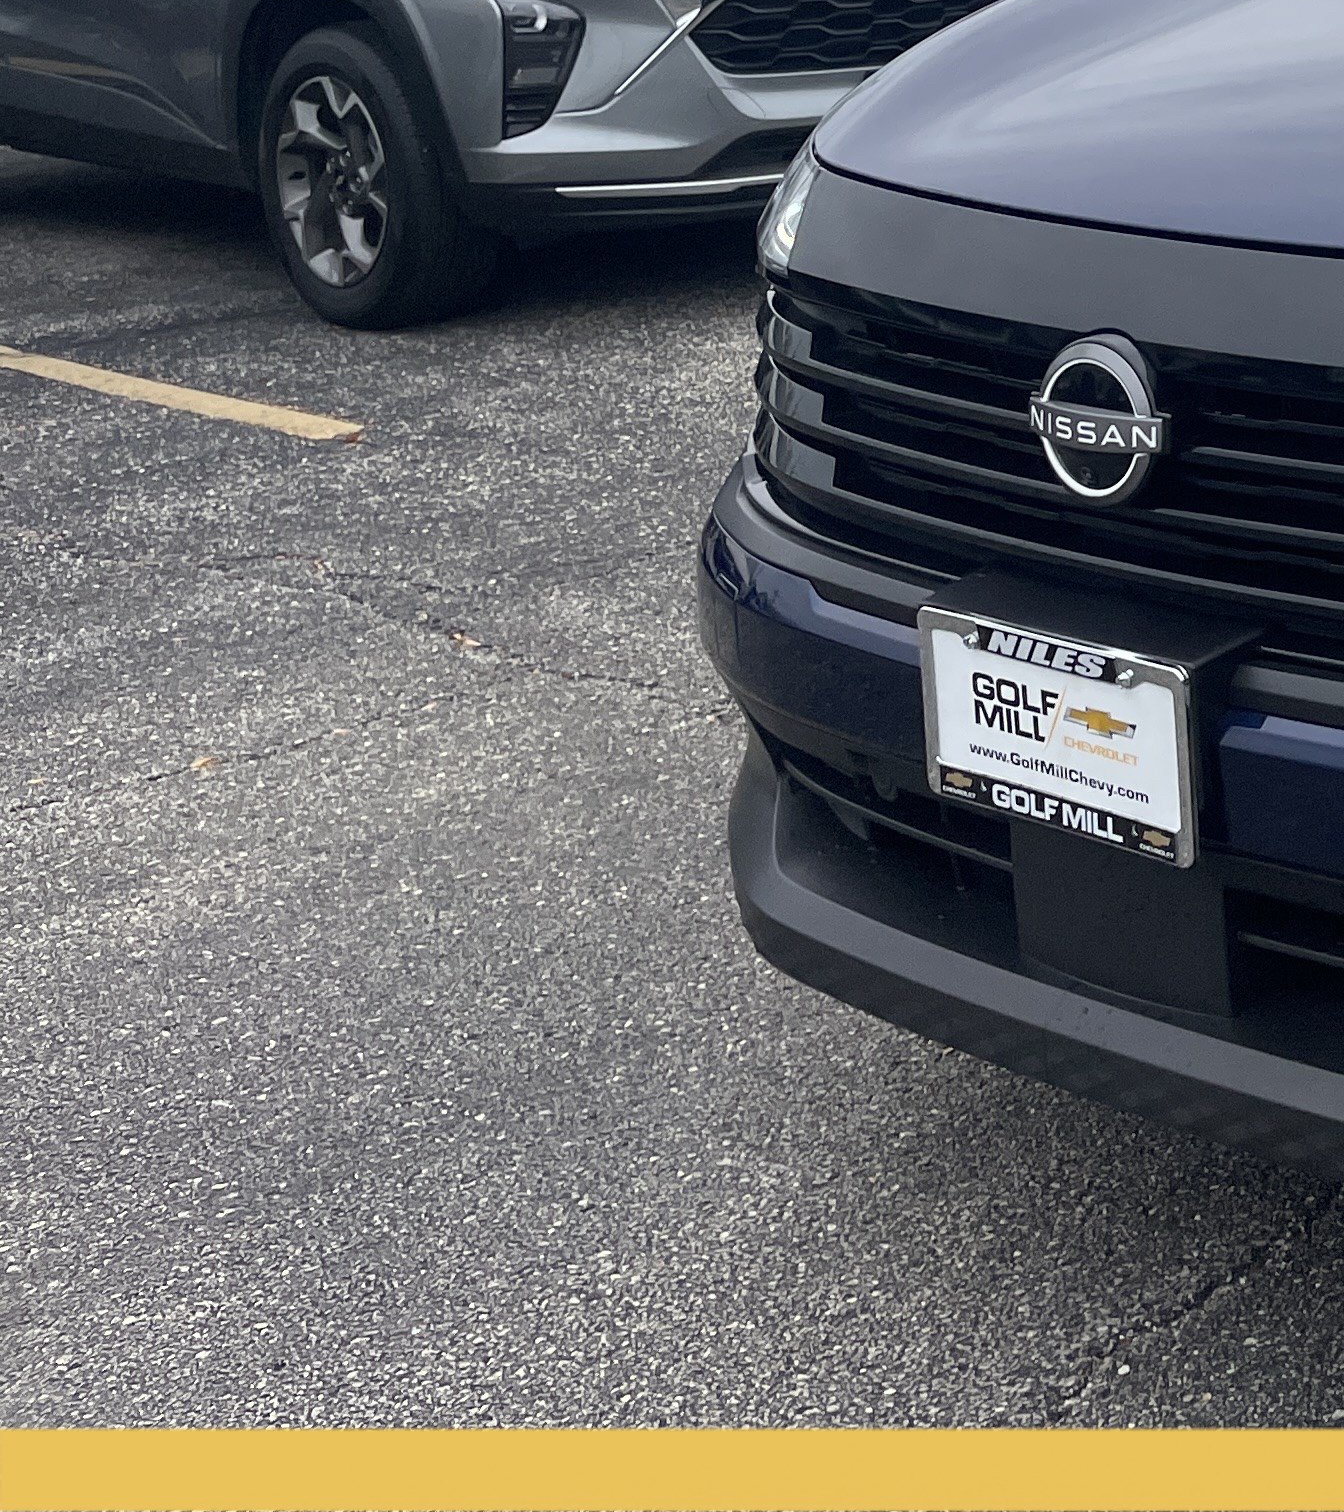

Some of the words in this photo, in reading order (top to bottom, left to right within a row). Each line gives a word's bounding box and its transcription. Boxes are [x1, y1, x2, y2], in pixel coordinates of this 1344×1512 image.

[1030, 404, 1158, 449] NISSAN
[986, 630, 1107, 679] NILES
[971, 671, 1060, 717] GOLF
[973, 698, 1047, 744] MILL
[969, 742, 1150, 806] www.GolfMillChevy.com
[1063, 735, 1140, 767] CHEVROLET
[991, 783, 1060, 821] GOLF
[1062, 802, 1125, 844] MILL
